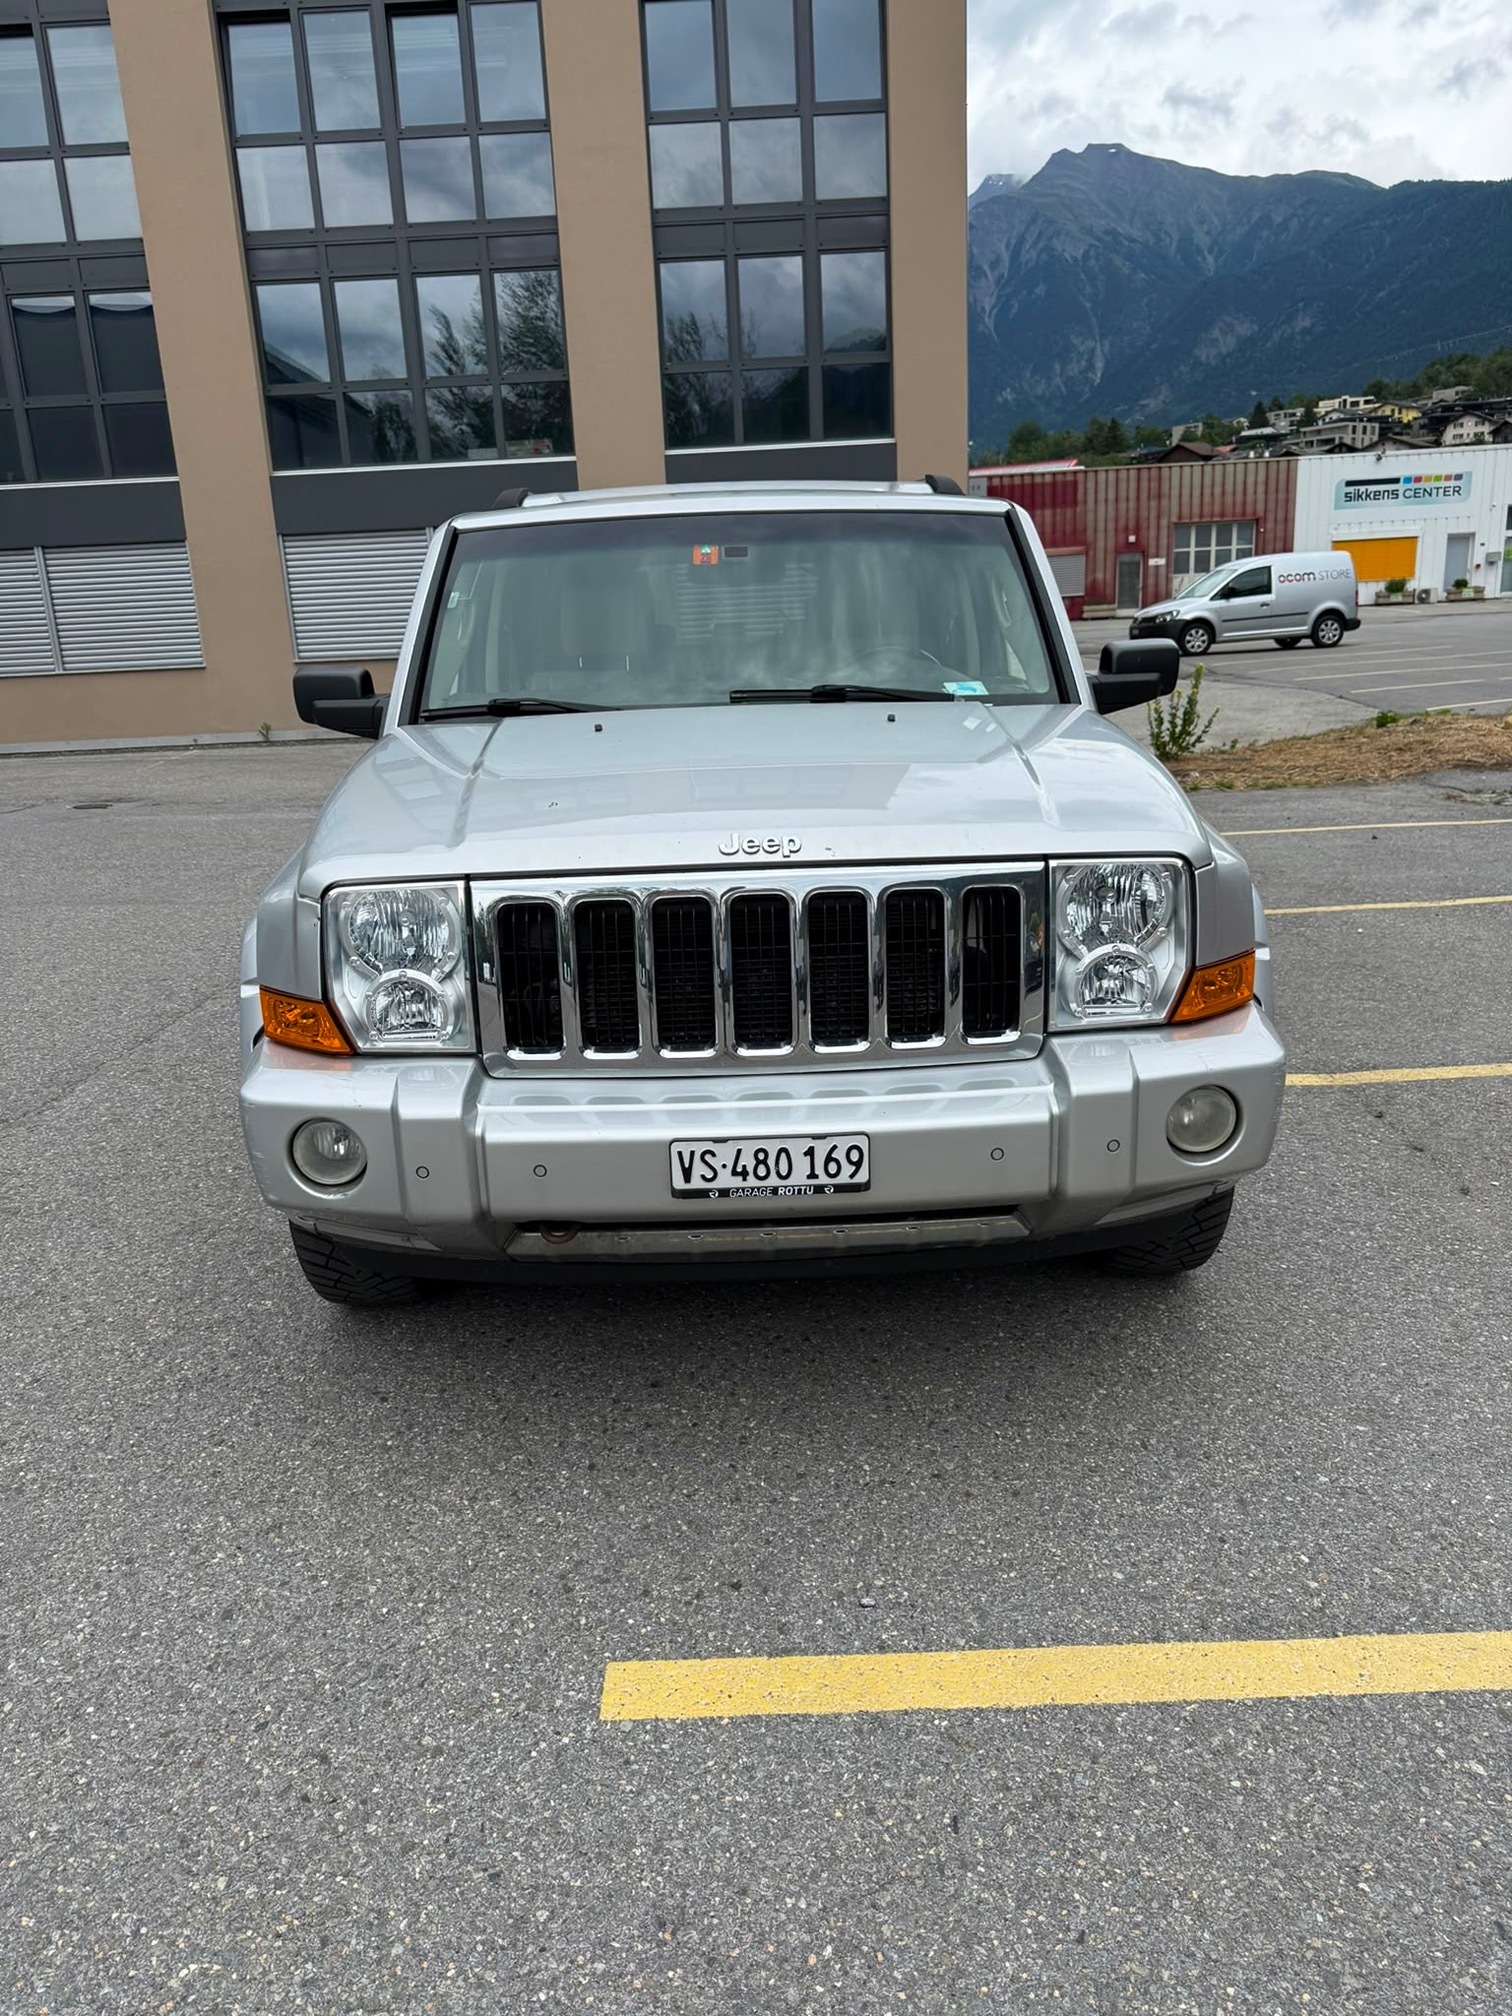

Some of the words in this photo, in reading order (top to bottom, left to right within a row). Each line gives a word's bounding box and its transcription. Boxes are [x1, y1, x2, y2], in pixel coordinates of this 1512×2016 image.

[1344, 488, 1399, 502] sikkens
[1402, 485, 1462, 499] CENTER
[1318, 568, 1351, 581] STORE
[718, 833, 802, 858] Jeep
[729, 1187, 774, 1198] GARAGE
[778, 1185, 814, 1196] ROTTU
